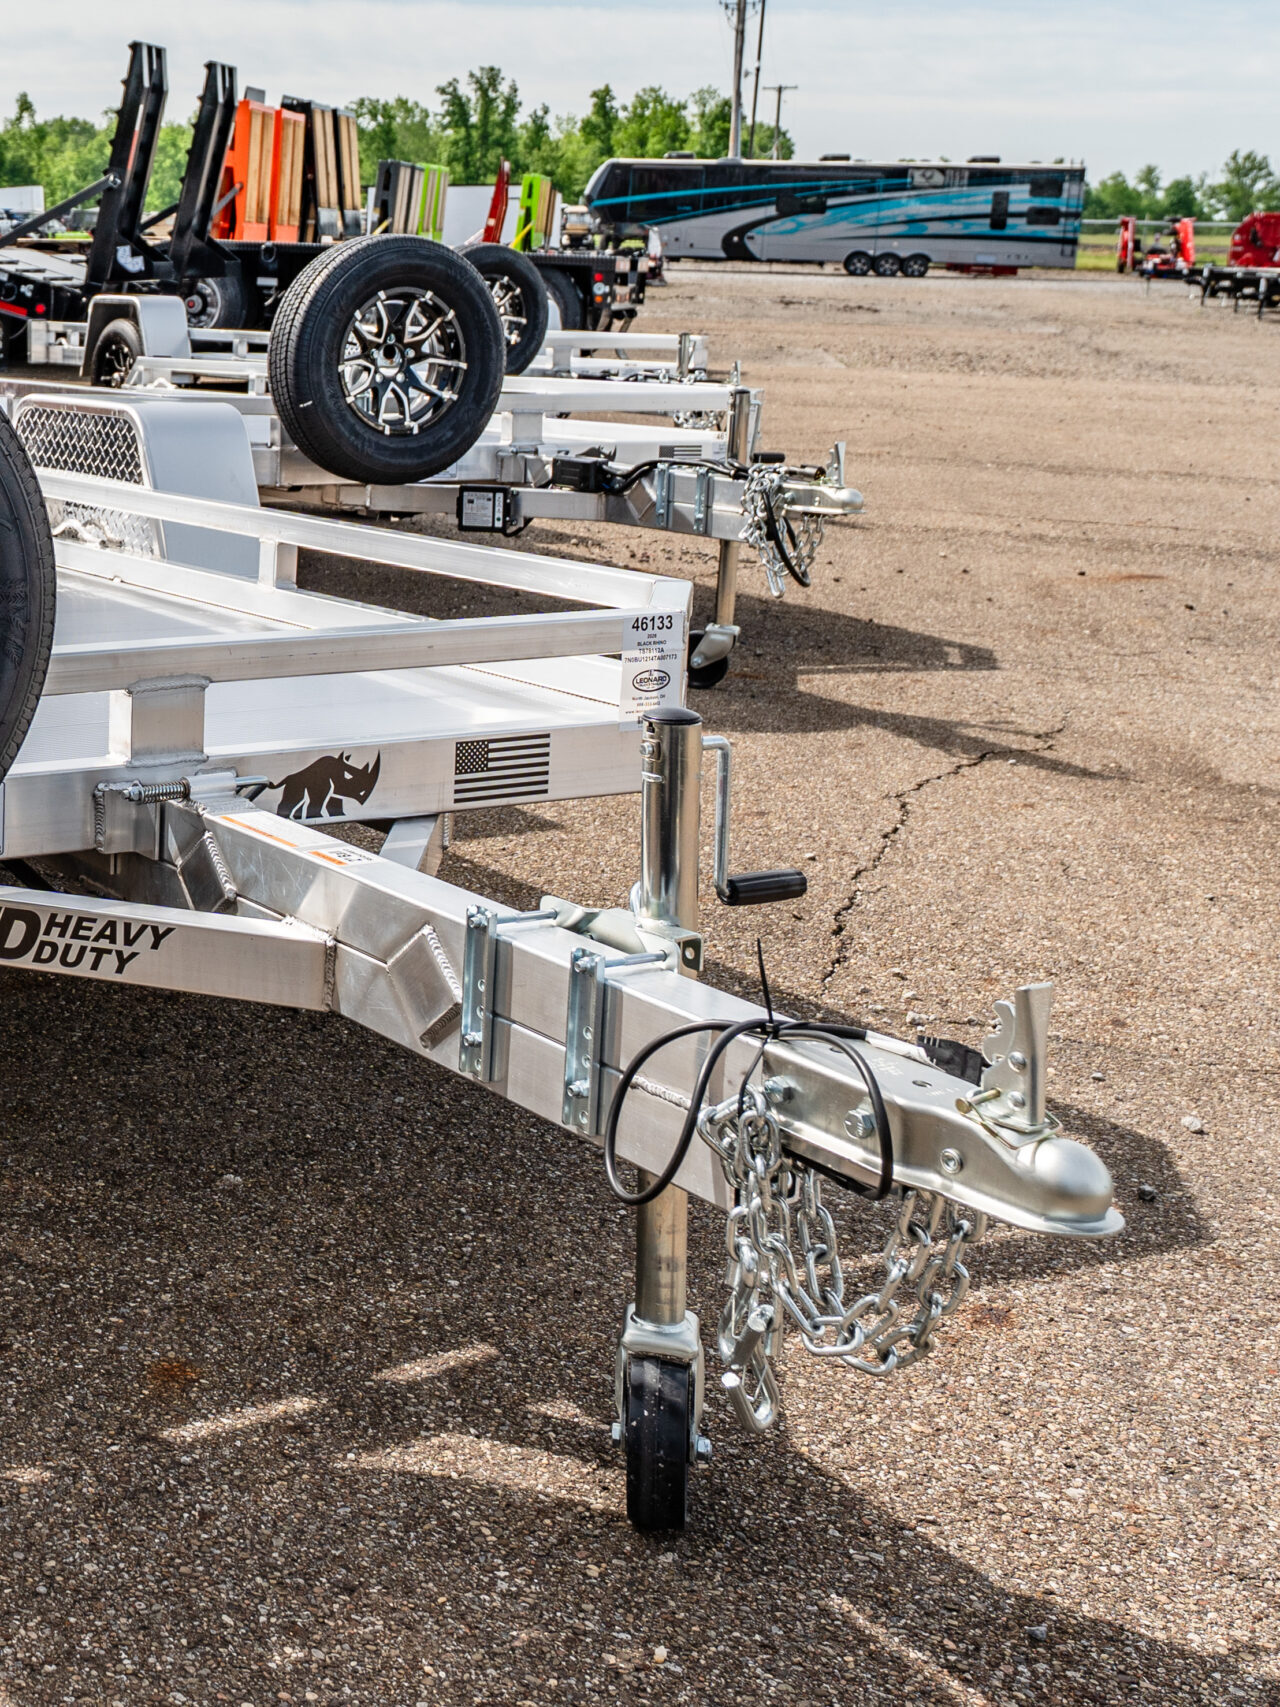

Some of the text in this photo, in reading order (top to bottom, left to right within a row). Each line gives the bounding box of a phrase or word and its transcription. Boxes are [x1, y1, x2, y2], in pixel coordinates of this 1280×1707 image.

[631, 614, 674, 632] 46133
[635, 675, 667, 684] LEONARD
[42, 912, 177, 951] HEAVY
[31, 939, 140, 975] DUTY
